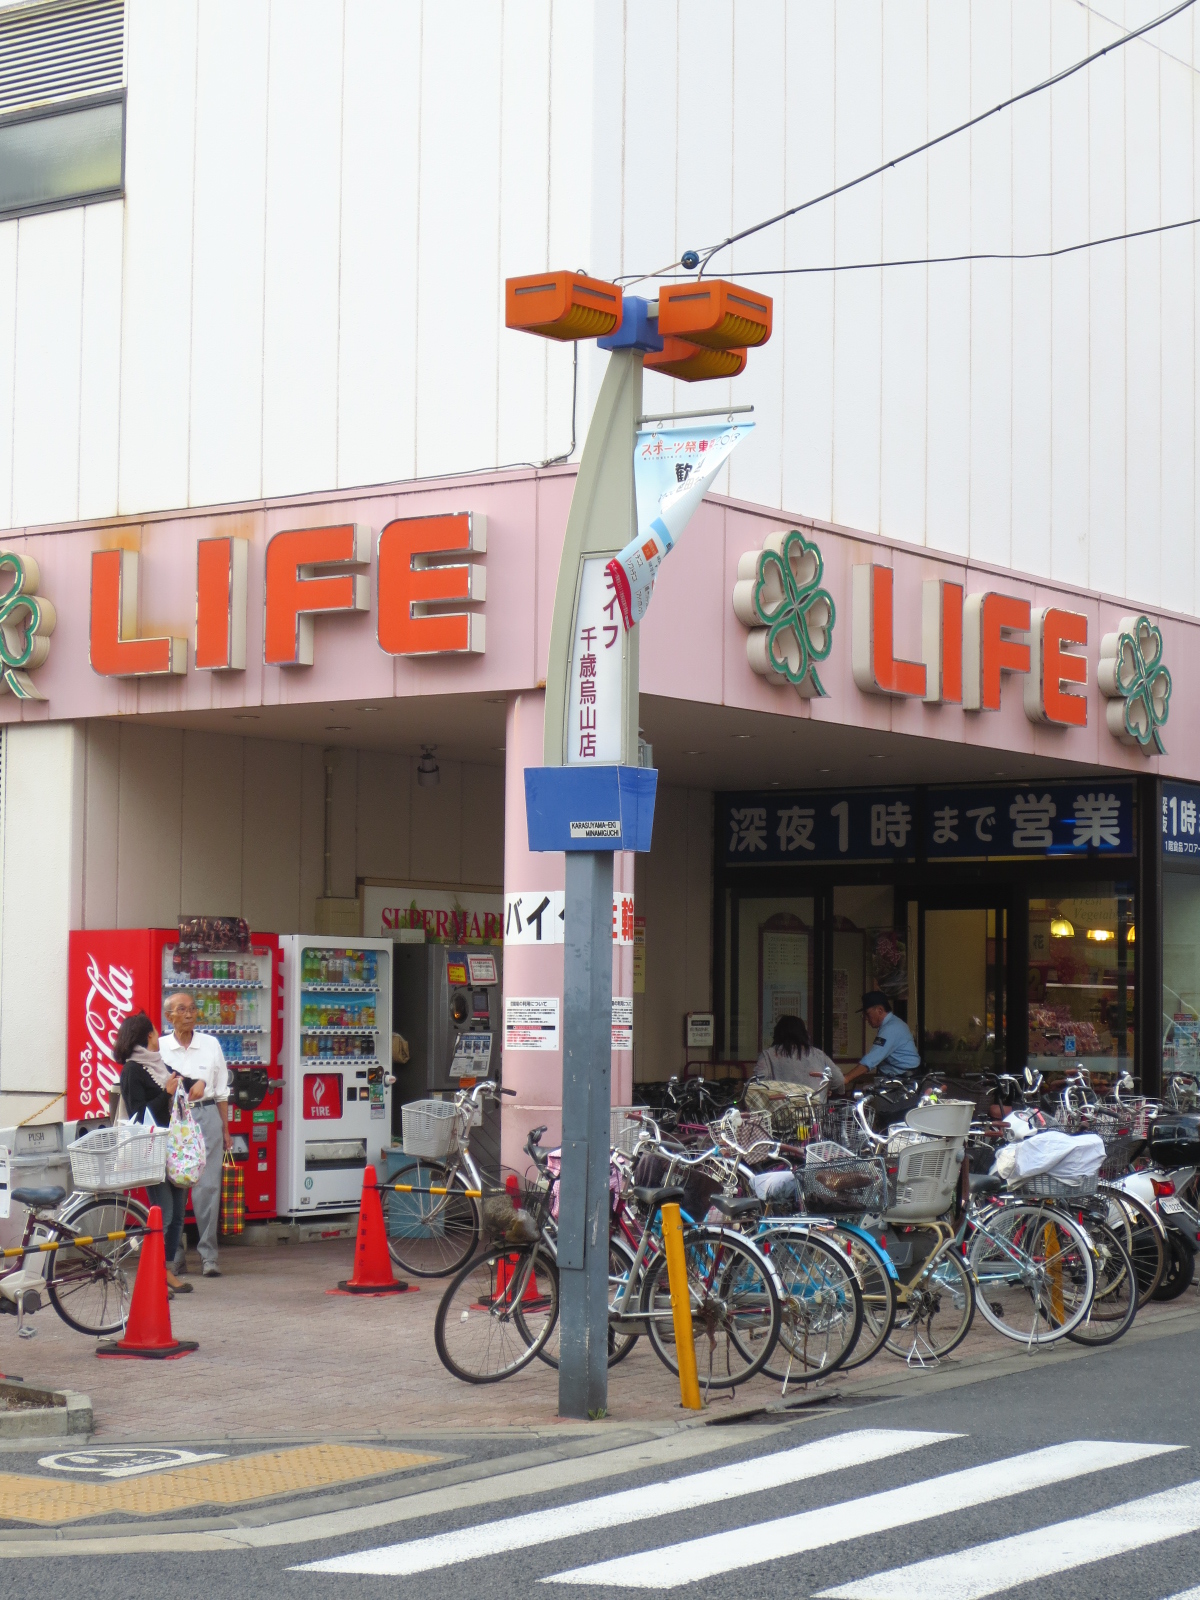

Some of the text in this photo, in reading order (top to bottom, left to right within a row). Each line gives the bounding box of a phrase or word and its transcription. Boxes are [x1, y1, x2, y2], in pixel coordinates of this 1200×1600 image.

[90, 511, 487, 678] LIFE
[852, 563, 1088, 728] LIFE
[579, 626, 598, 758] 千歳烏山店
[585, 829, 619, 837] MINAMIGUCHI
[729, 793, 1122, 852] 深夜1時まで営業
[506, 895, 565, 941] バイ
[310, 1105, 331, 1116] FIRE
[28, 1132, 45, 1142] PUSH
